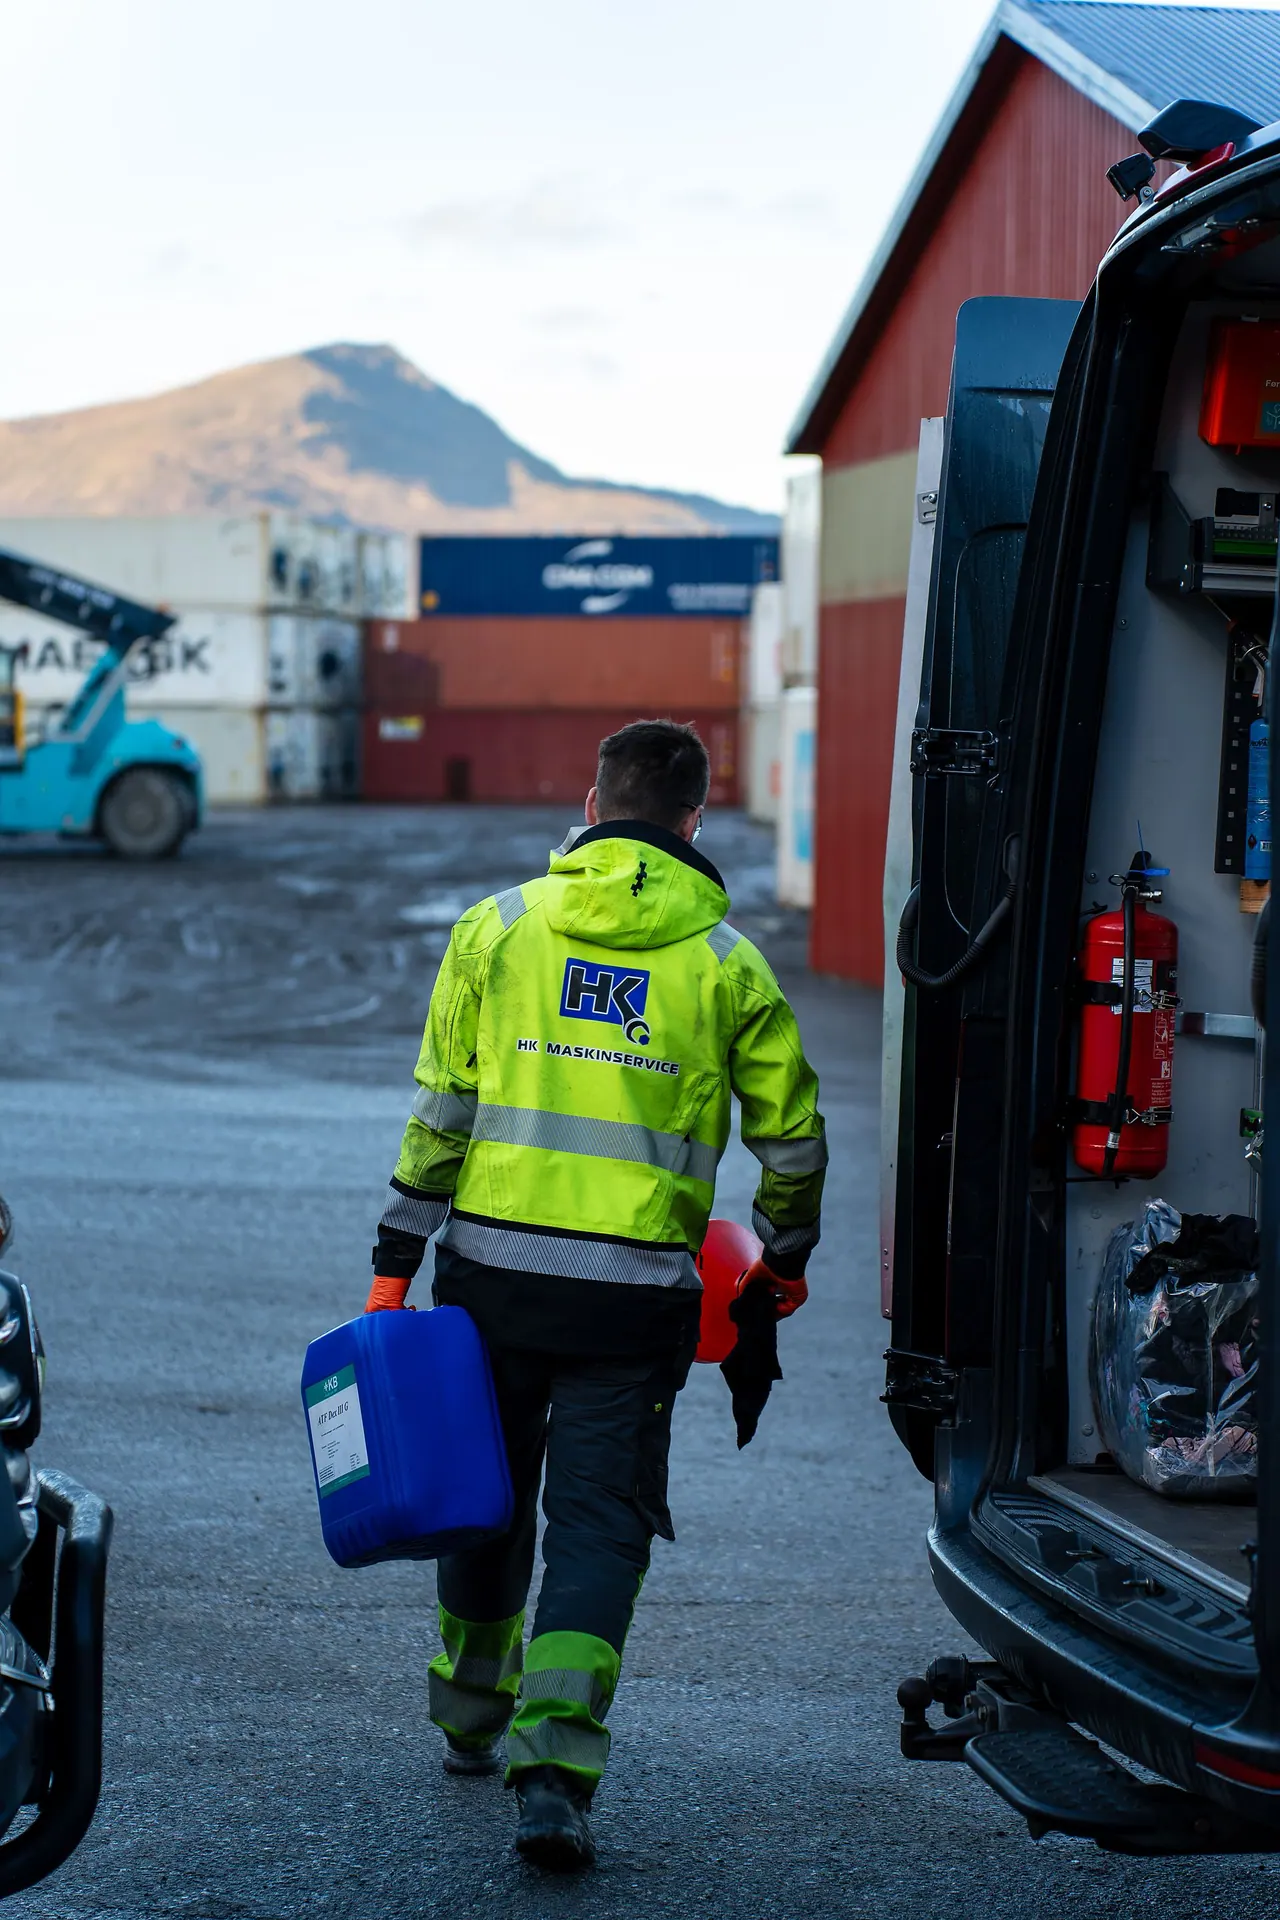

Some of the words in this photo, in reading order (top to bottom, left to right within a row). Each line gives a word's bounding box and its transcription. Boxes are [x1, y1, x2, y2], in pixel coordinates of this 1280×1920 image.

[565, 965, 650, 1045] HK
[517, 1039, 539, 1052] HK
[546, 1042, 679, 1075] MASKINSERVICE
[317, 1412, 328, 1426] ATF
